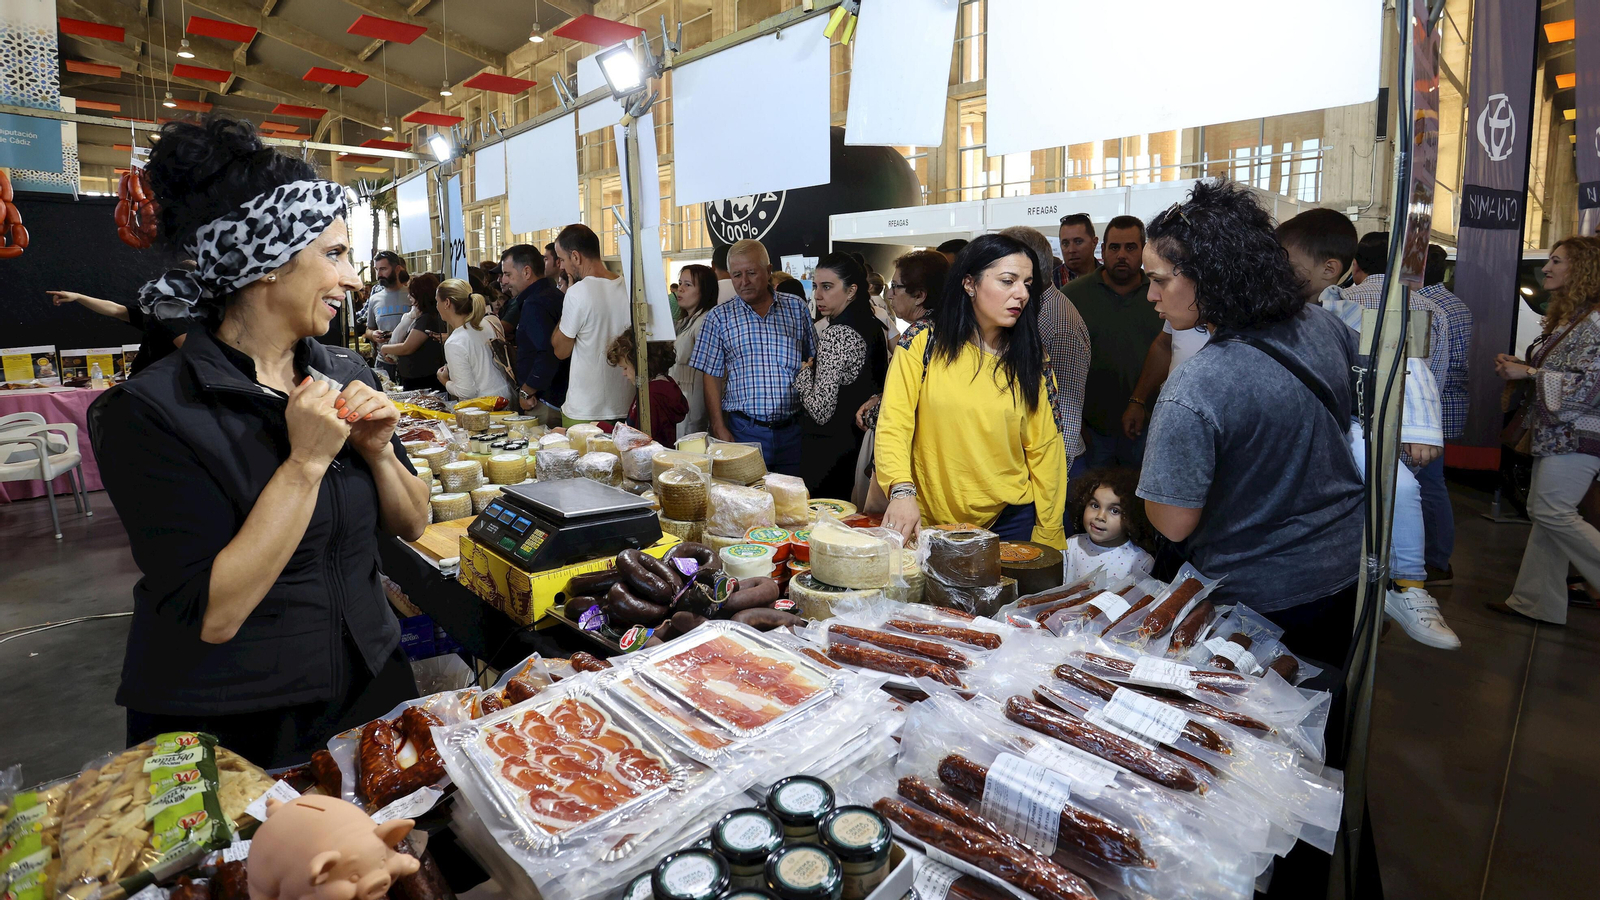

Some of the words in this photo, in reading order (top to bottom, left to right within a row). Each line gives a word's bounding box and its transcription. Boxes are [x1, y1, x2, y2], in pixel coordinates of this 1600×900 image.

[9, 136, 31, 146] Cádiz
[1027, 205, 1058, 216] RFEAGAS
[888, 218, 909, 228] RFEAGAS
[721, 220, 759, 241] 100%
